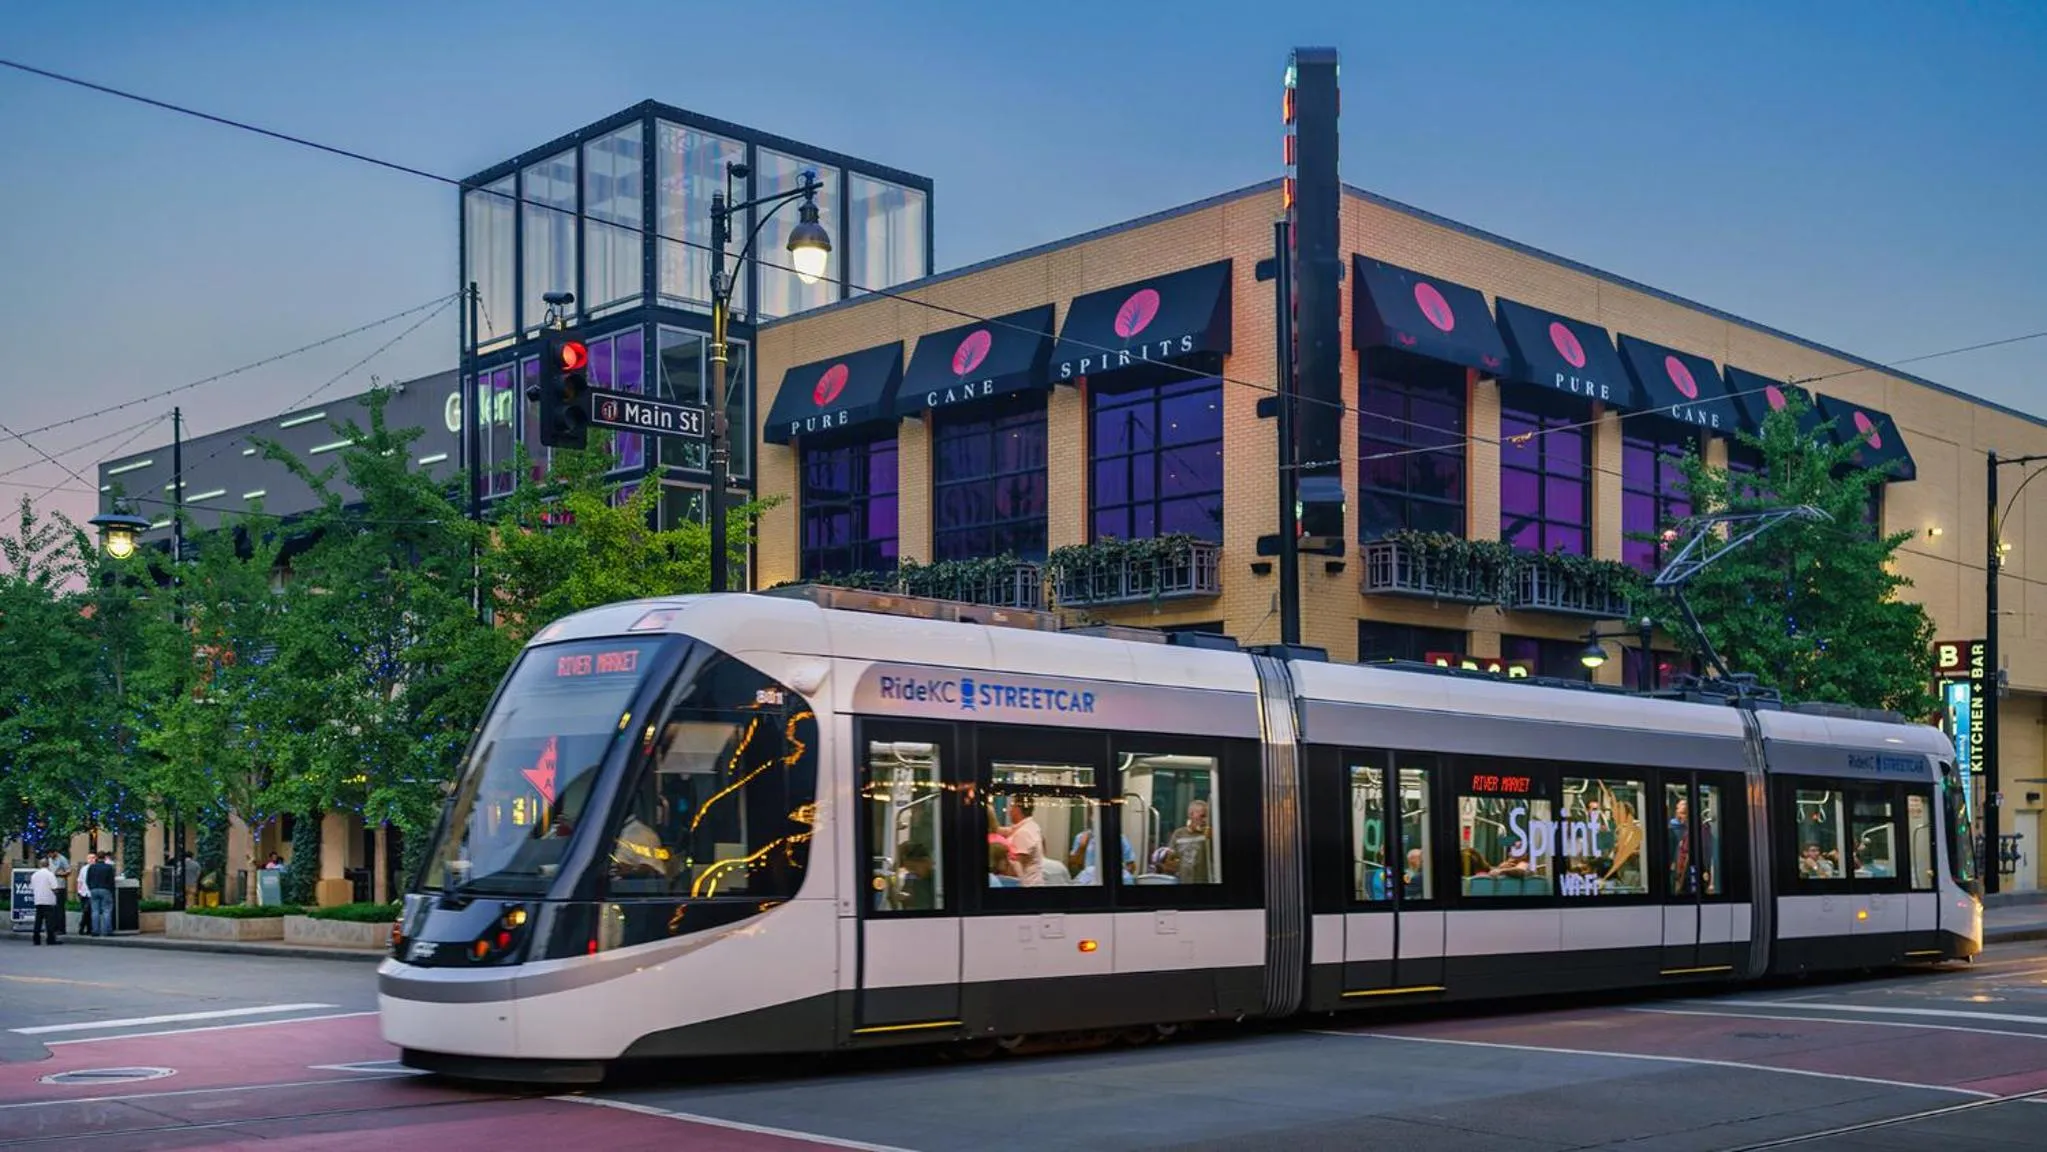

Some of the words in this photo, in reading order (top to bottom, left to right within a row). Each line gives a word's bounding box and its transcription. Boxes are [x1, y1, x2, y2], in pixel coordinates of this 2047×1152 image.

[1060, 335, 1193, 378] SPIRITS
[927, 380, 994, 407] CANE
[1556, 373, 1610, 400] PURE
[625, 402, 672, 428] Main
[679, 411, 699, 432] St
[791, 411, 849, 435] PURE
[1672, 404, 1720, 428] CANE
[557, 655, 593, 677] RIVER
[596, 650, 640, 673] MARKET
[1971, 644, 1984, 679] BAR
[879, 675, 957, 704] RideKC
[980, 682, 1096, 713] STREETCAR
[1971, 701, 1984, 772] KITCHEN
[1472, 775, 1499, 791] RIVER
[1501, 776, 1530, 793] MARKET
[1509, 807, 1602, 872] Sprint
